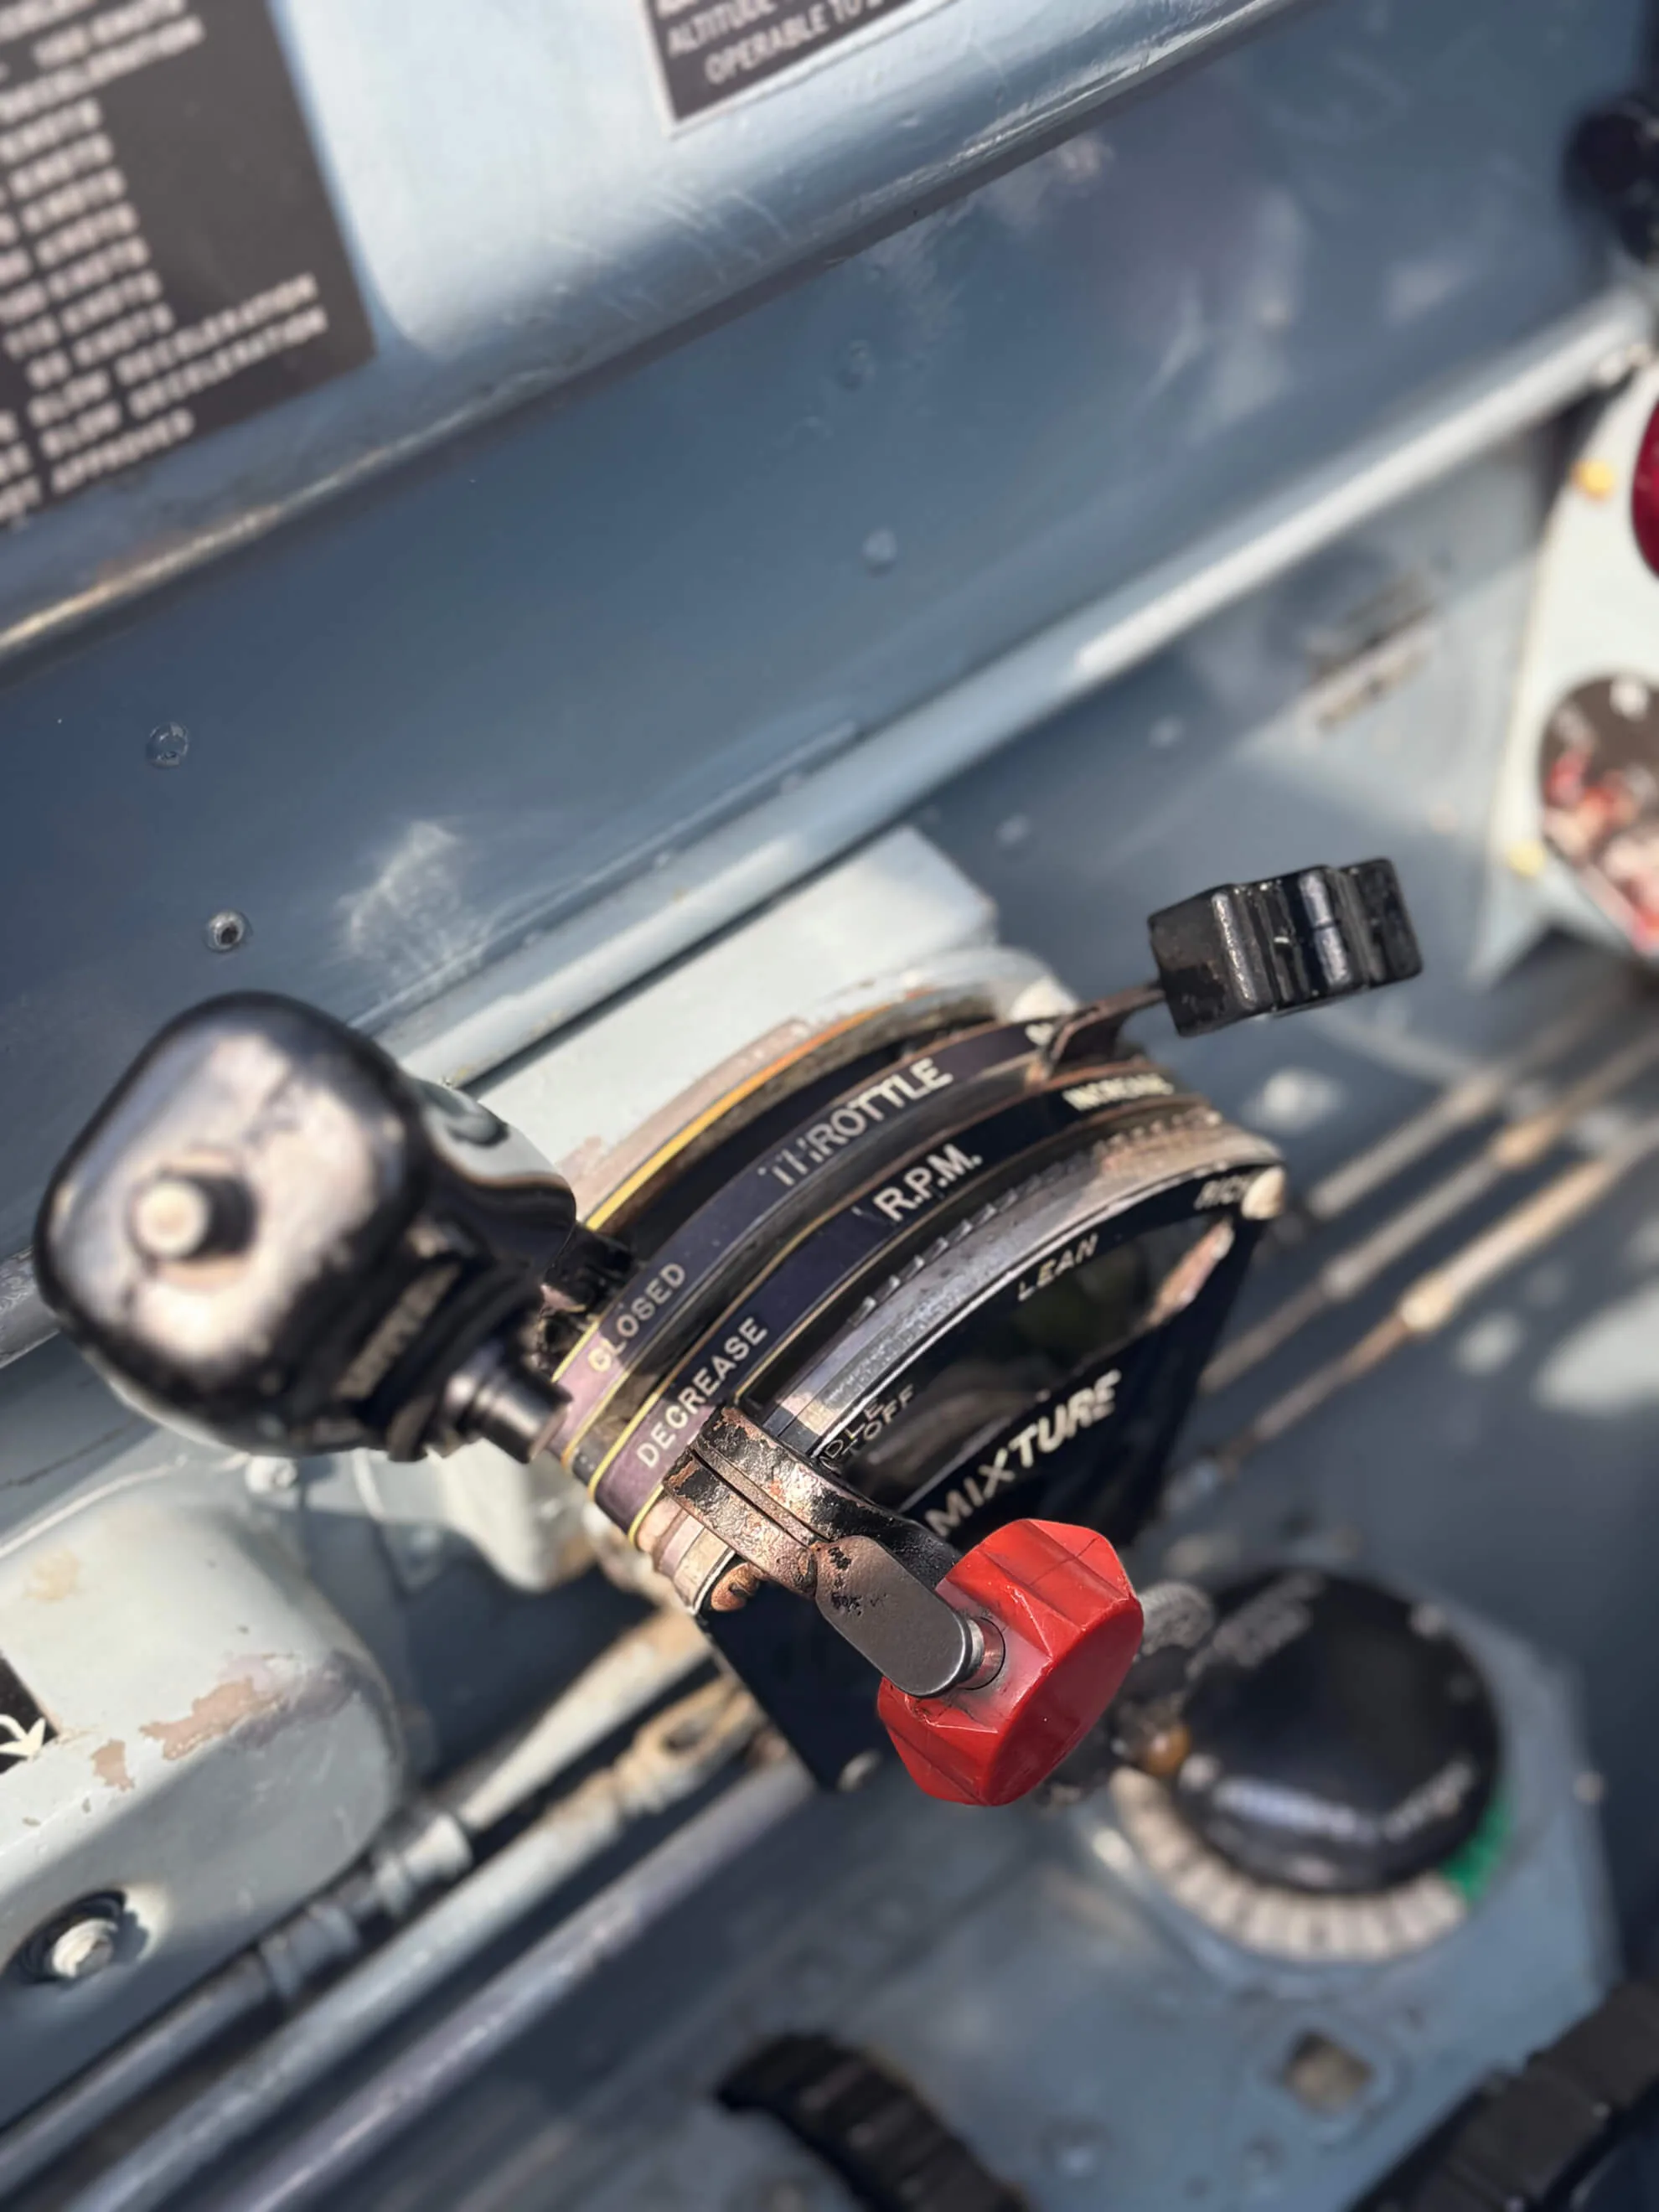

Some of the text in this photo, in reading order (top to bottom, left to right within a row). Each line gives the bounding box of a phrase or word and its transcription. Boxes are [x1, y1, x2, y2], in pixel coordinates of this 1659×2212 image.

[705, 3, 830, 85] OPERABLE
[757, 1057, 954, 1186] THROTTLE
[872, 1143, 982, 1222] R.P.M.
[588, 1263, 685, 1372] CLOSED
[1017, 1232, 1098, 1302] LEAN
[636, 1317, 768, 1468] DECREASE
[924, 1368, 1122, 1538] MIXTURE
